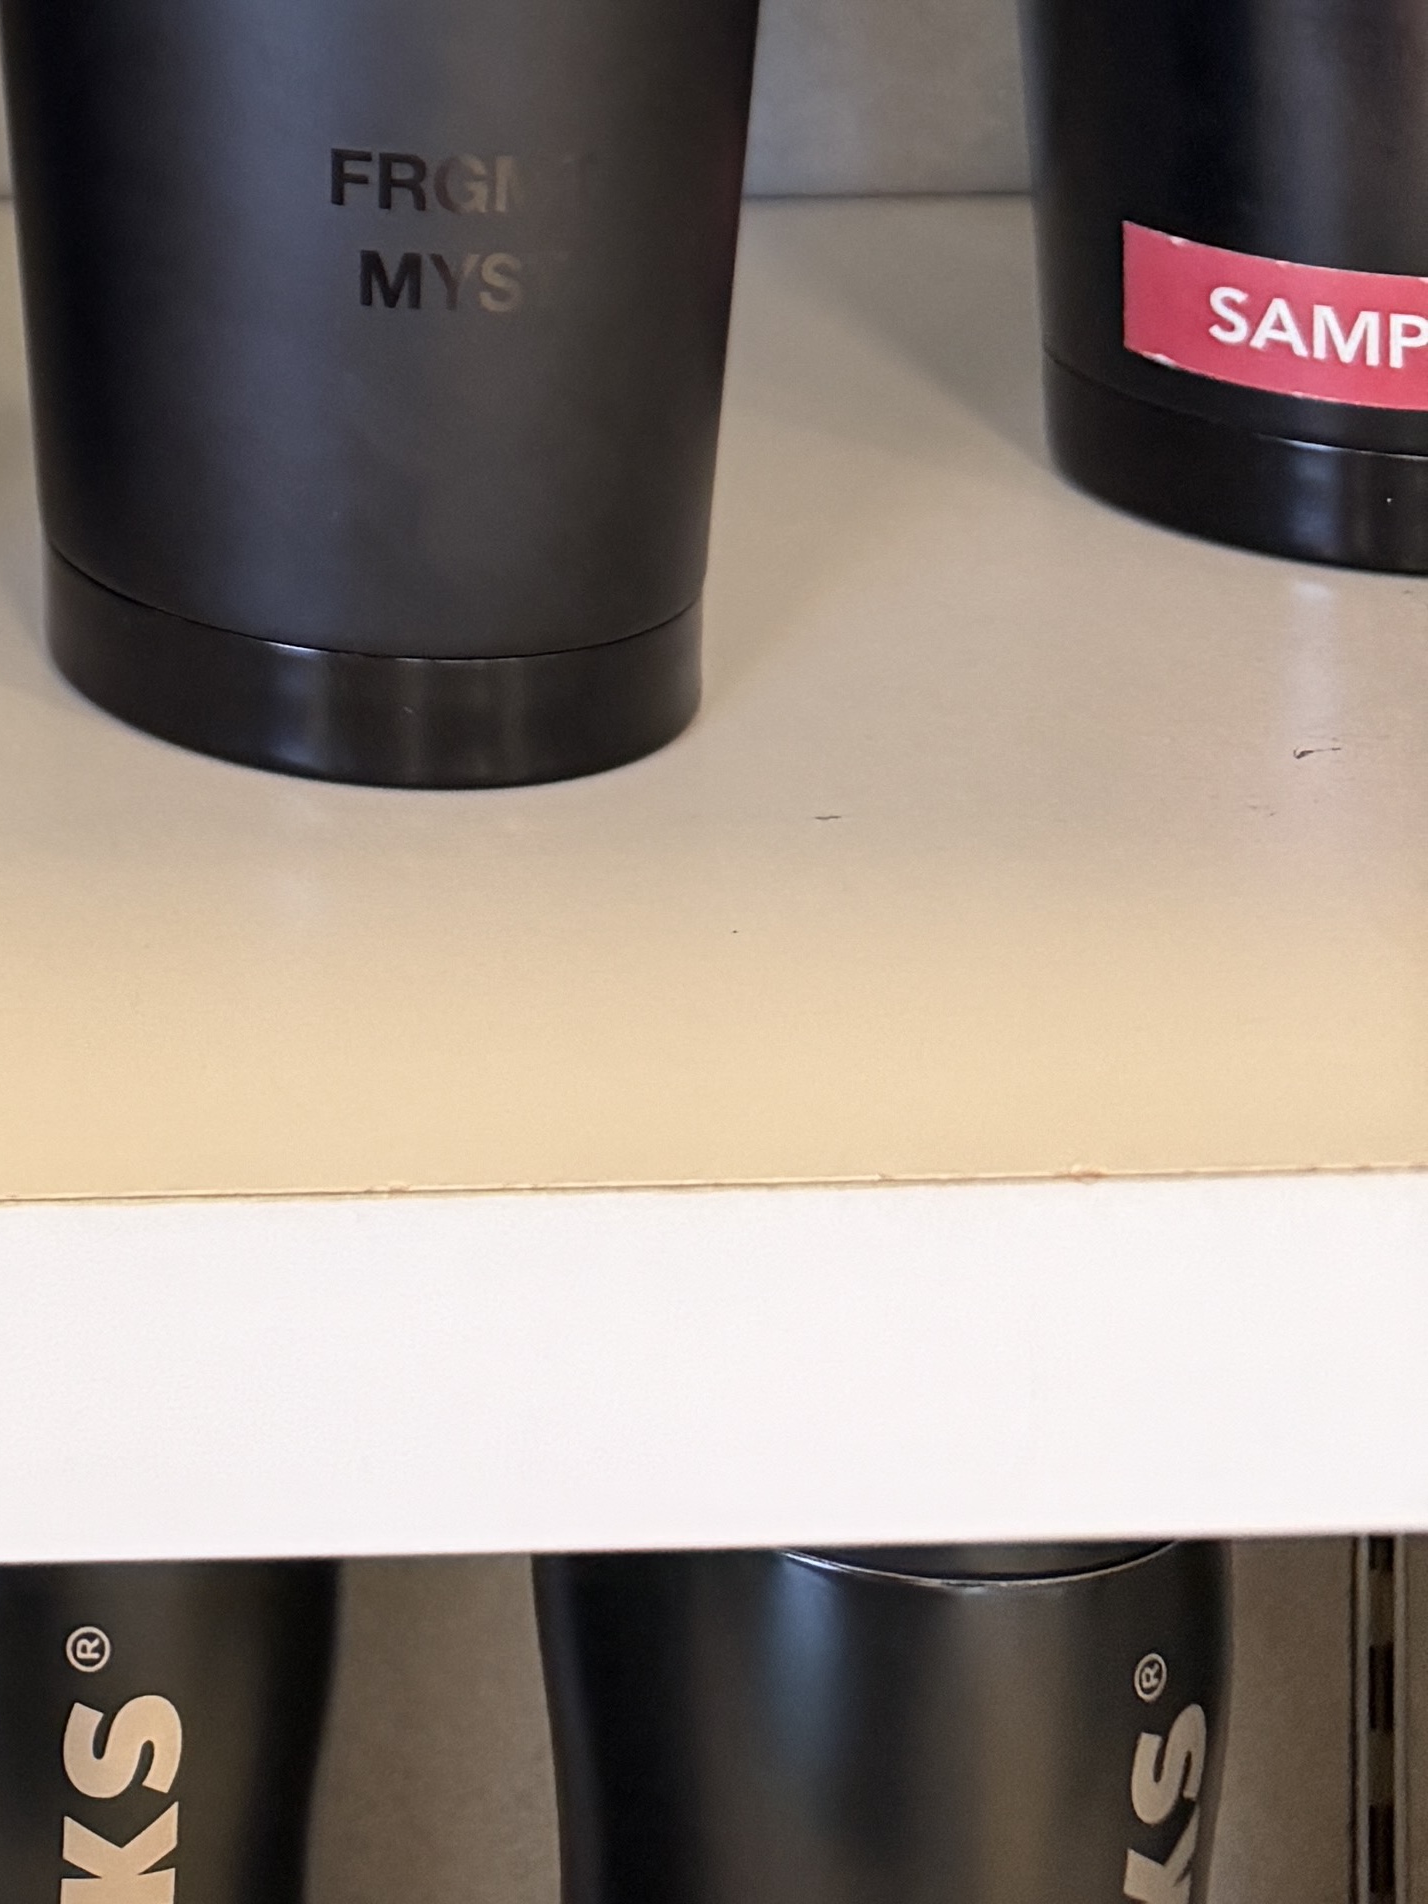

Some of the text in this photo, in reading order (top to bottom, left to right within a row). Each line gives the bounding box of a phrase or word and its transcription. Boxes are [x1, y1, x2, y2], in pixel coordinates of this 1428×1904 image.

[330, 148, 597, 213] FRG
[359, 249, 569, 312] MYS
[1208, 286, 1428, 369] SAMP
